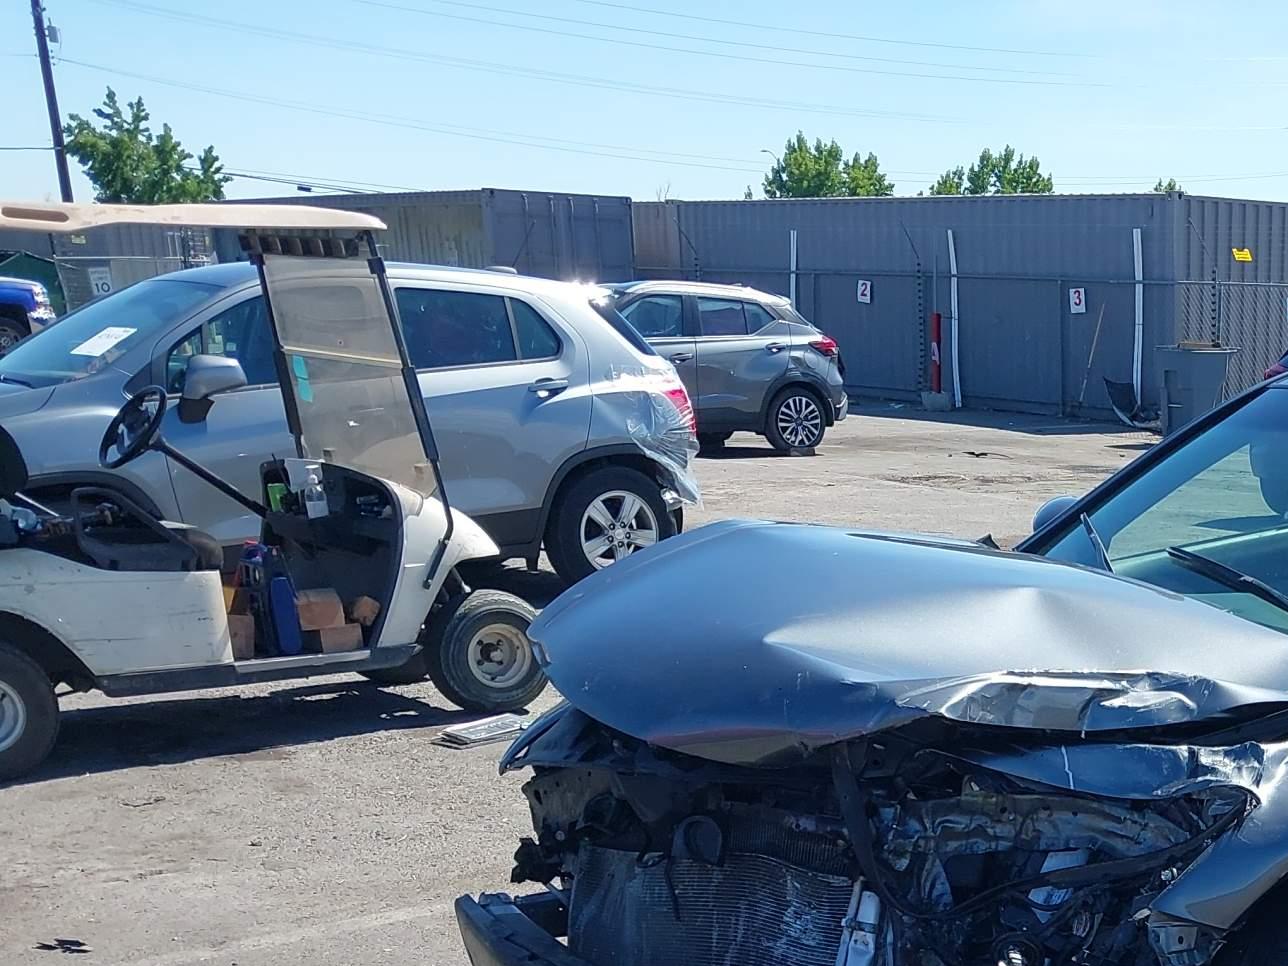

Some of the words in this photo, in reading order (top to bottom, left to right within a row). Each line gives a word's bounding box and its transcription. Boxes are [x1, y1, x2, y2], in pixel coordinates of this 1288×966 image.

[95, 282, 110, 293] 10
[860, 282, 868, 297] 2
[1073, 290, 1082, 306] 3
